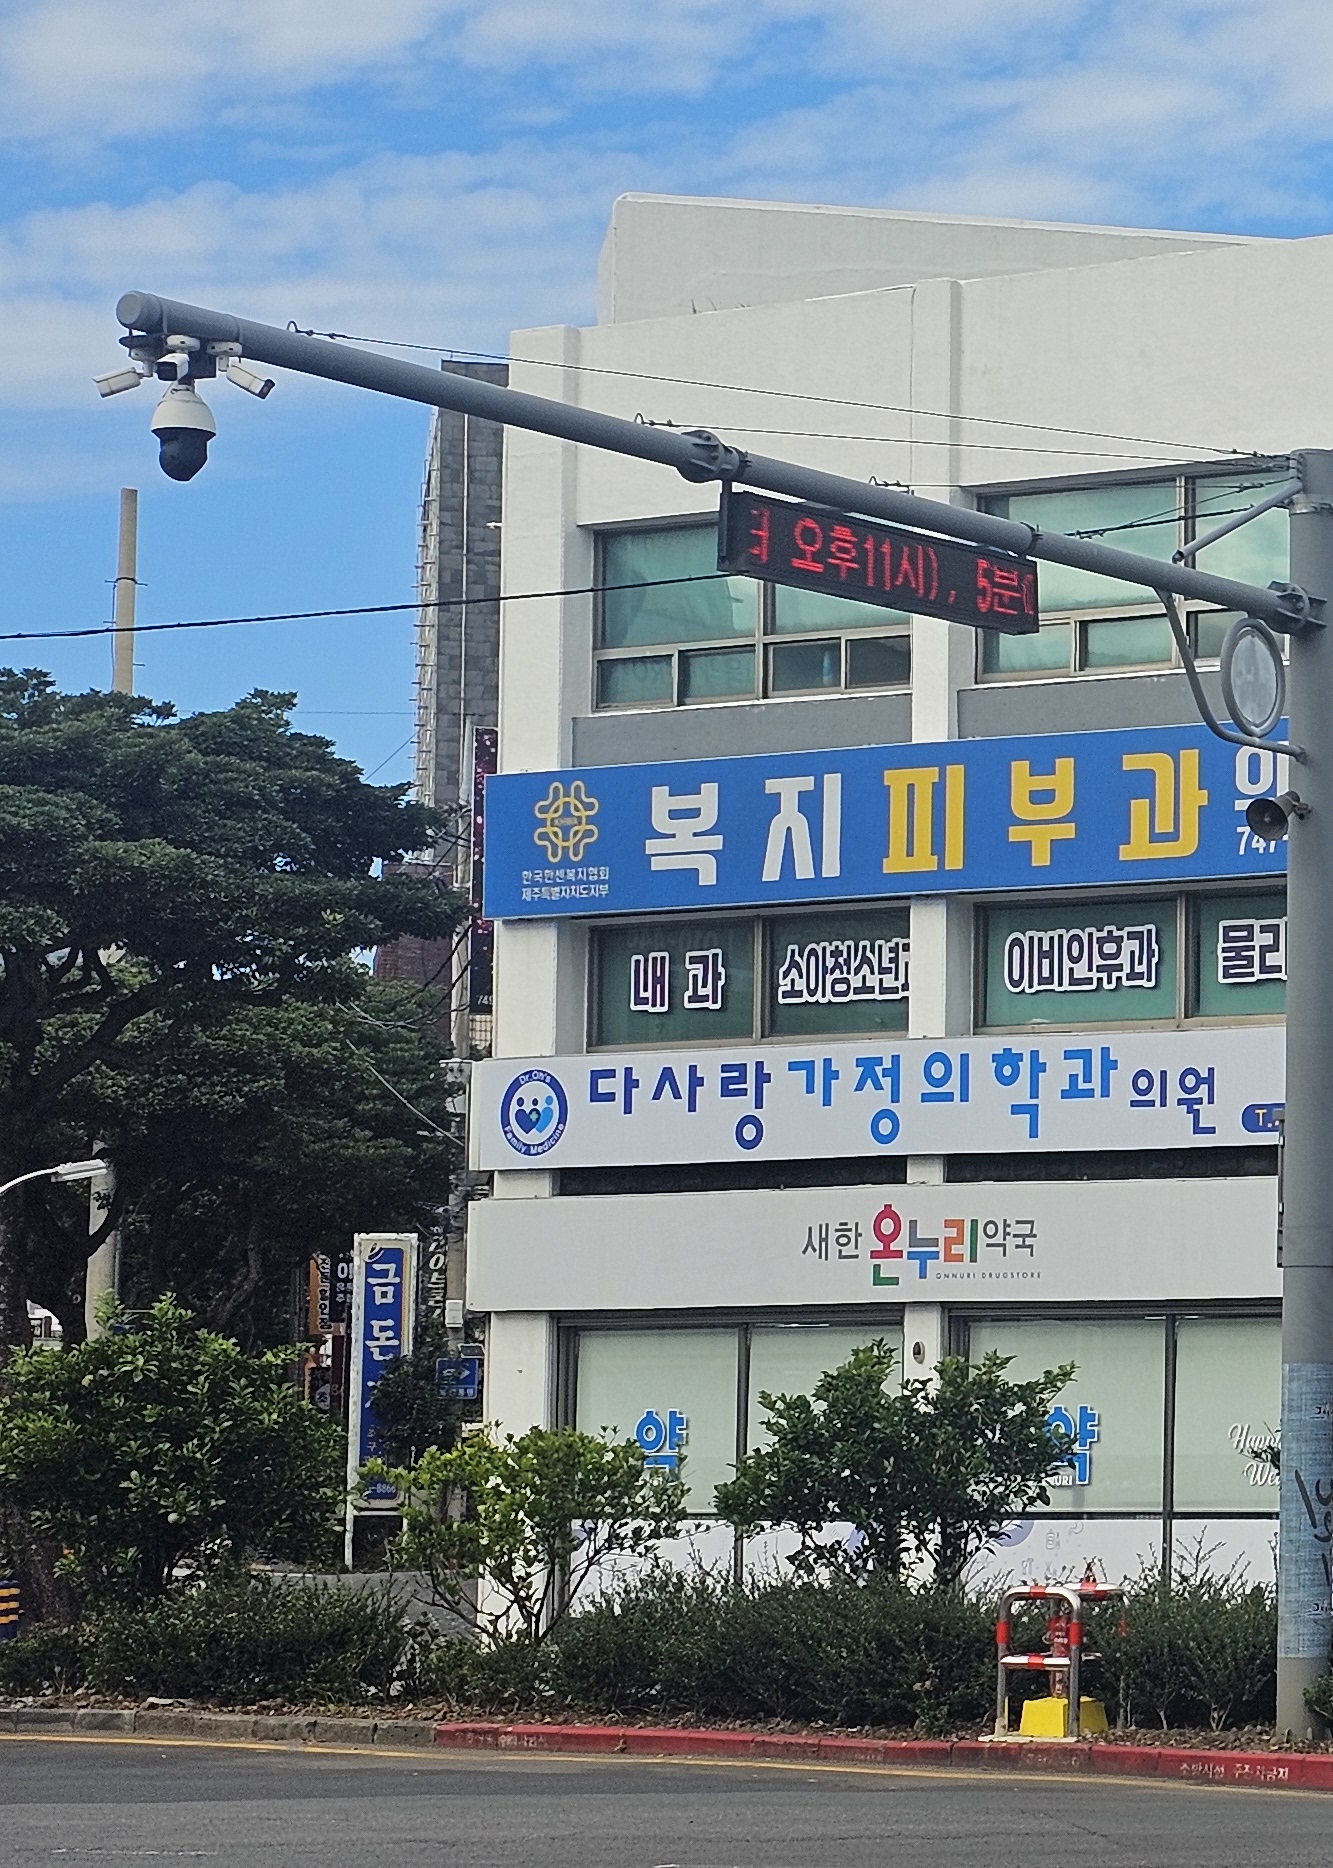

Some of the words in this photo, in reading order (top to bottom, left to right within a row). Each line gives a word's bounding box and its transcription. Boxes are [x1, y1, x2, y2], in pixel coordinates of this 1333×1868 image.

[522, 867, 610, 885] 한국한센복지협회
[521, 884, 610, 901] 제주특별자치도지부
[778, 937, 911, 1004] 소아청소년
[1004, 924, 1158, 993] 이비인후과
[504, 1125, 527, 1153] Family
[530, 1123, 564, 1154] Medicine
[936, 1272, 976, 1280] ONNURI
[981, 1272, 1042, 1280] DRUGSTORE
[1228, 1423, 1281, 1453] Happ
